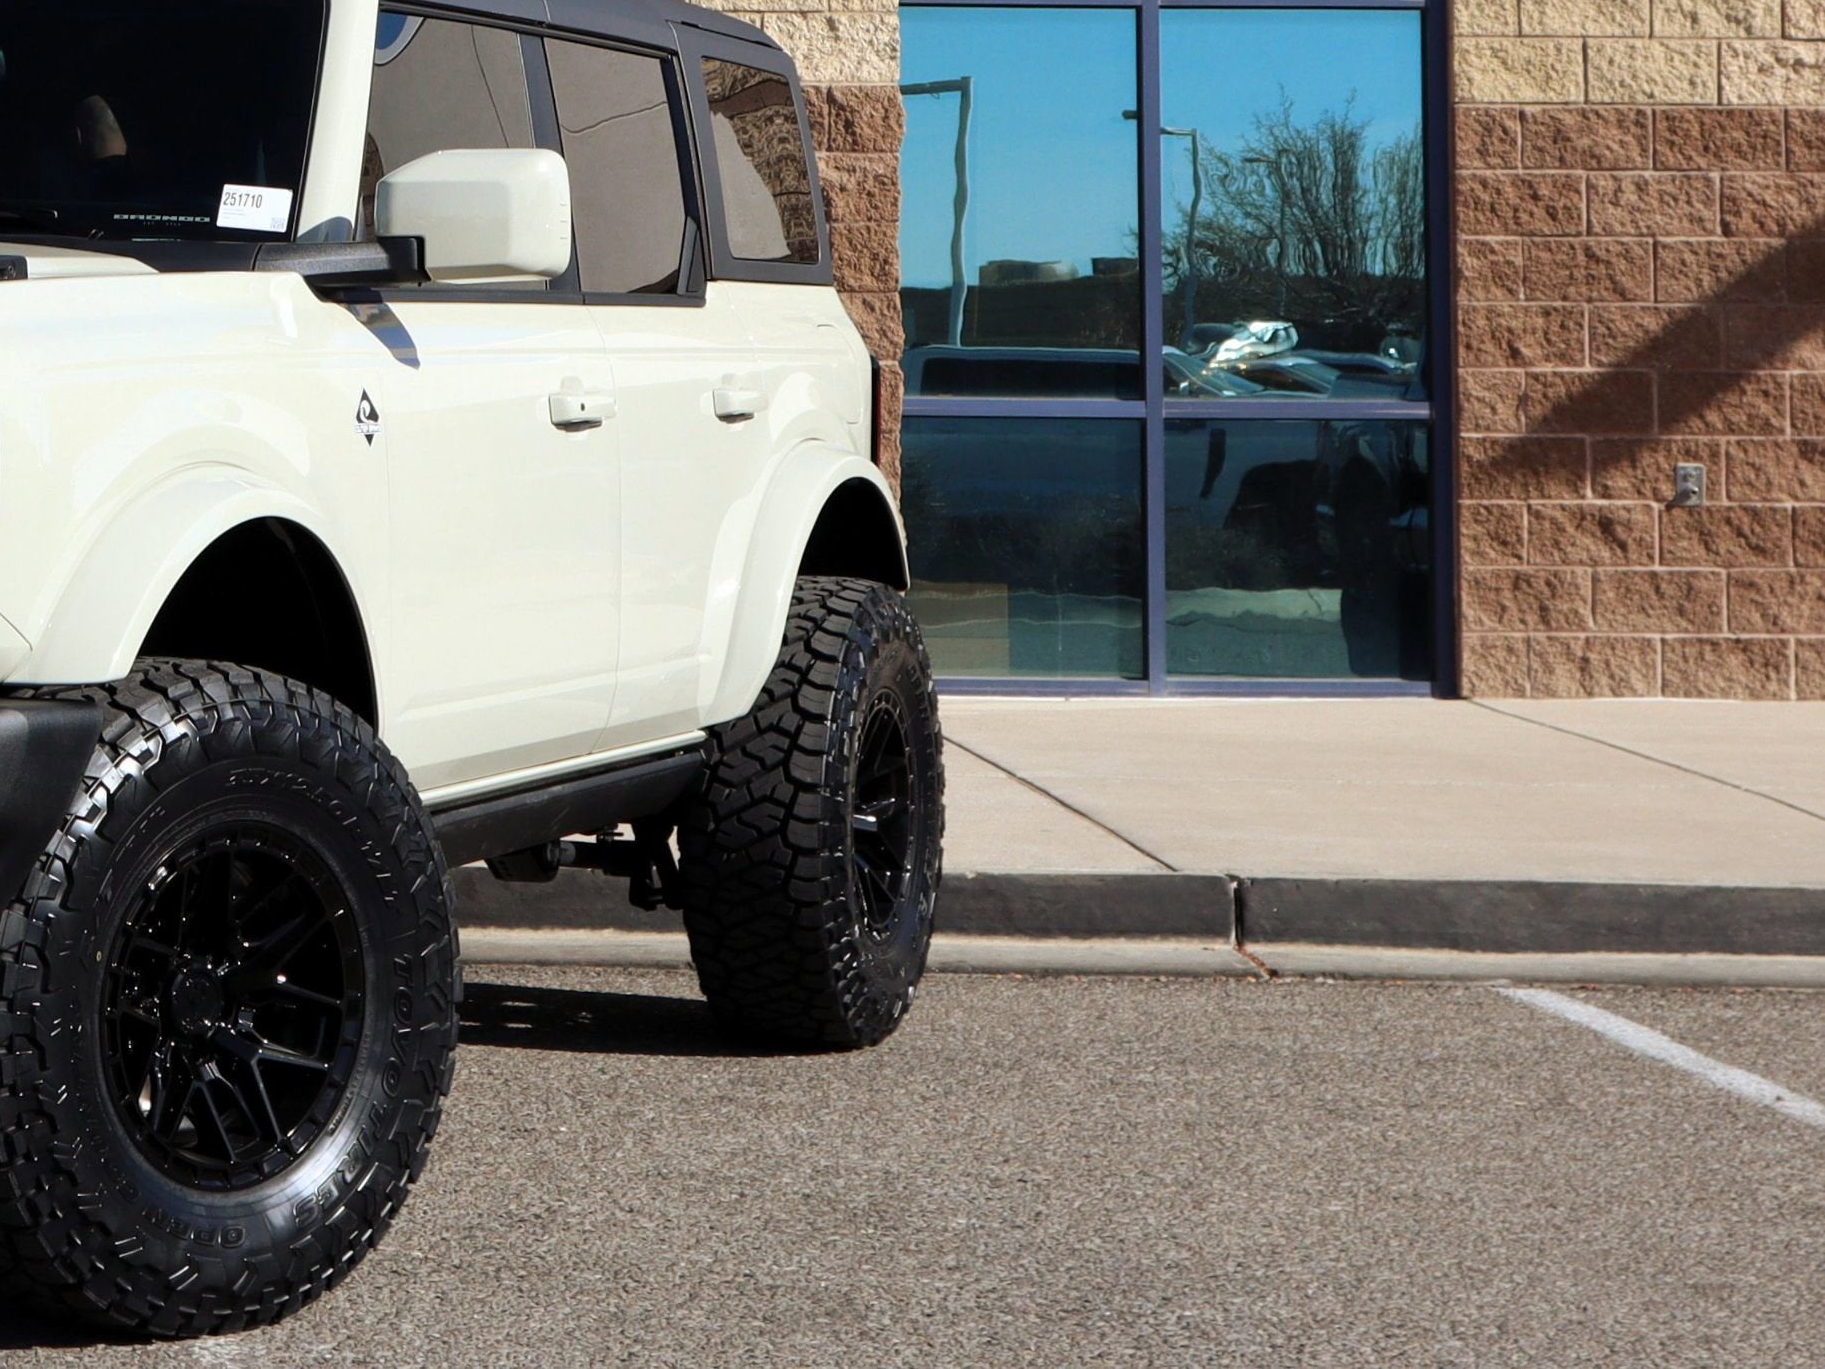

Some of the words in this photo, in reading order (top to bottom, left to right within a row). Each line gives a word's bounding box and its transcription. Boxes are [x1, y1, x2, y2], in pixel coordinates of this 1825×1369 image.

[223, 192, 263, 209] 251710
[381, 952, 414, 1099] TOYO
[292, 1100, 389, 1228] TIRES
